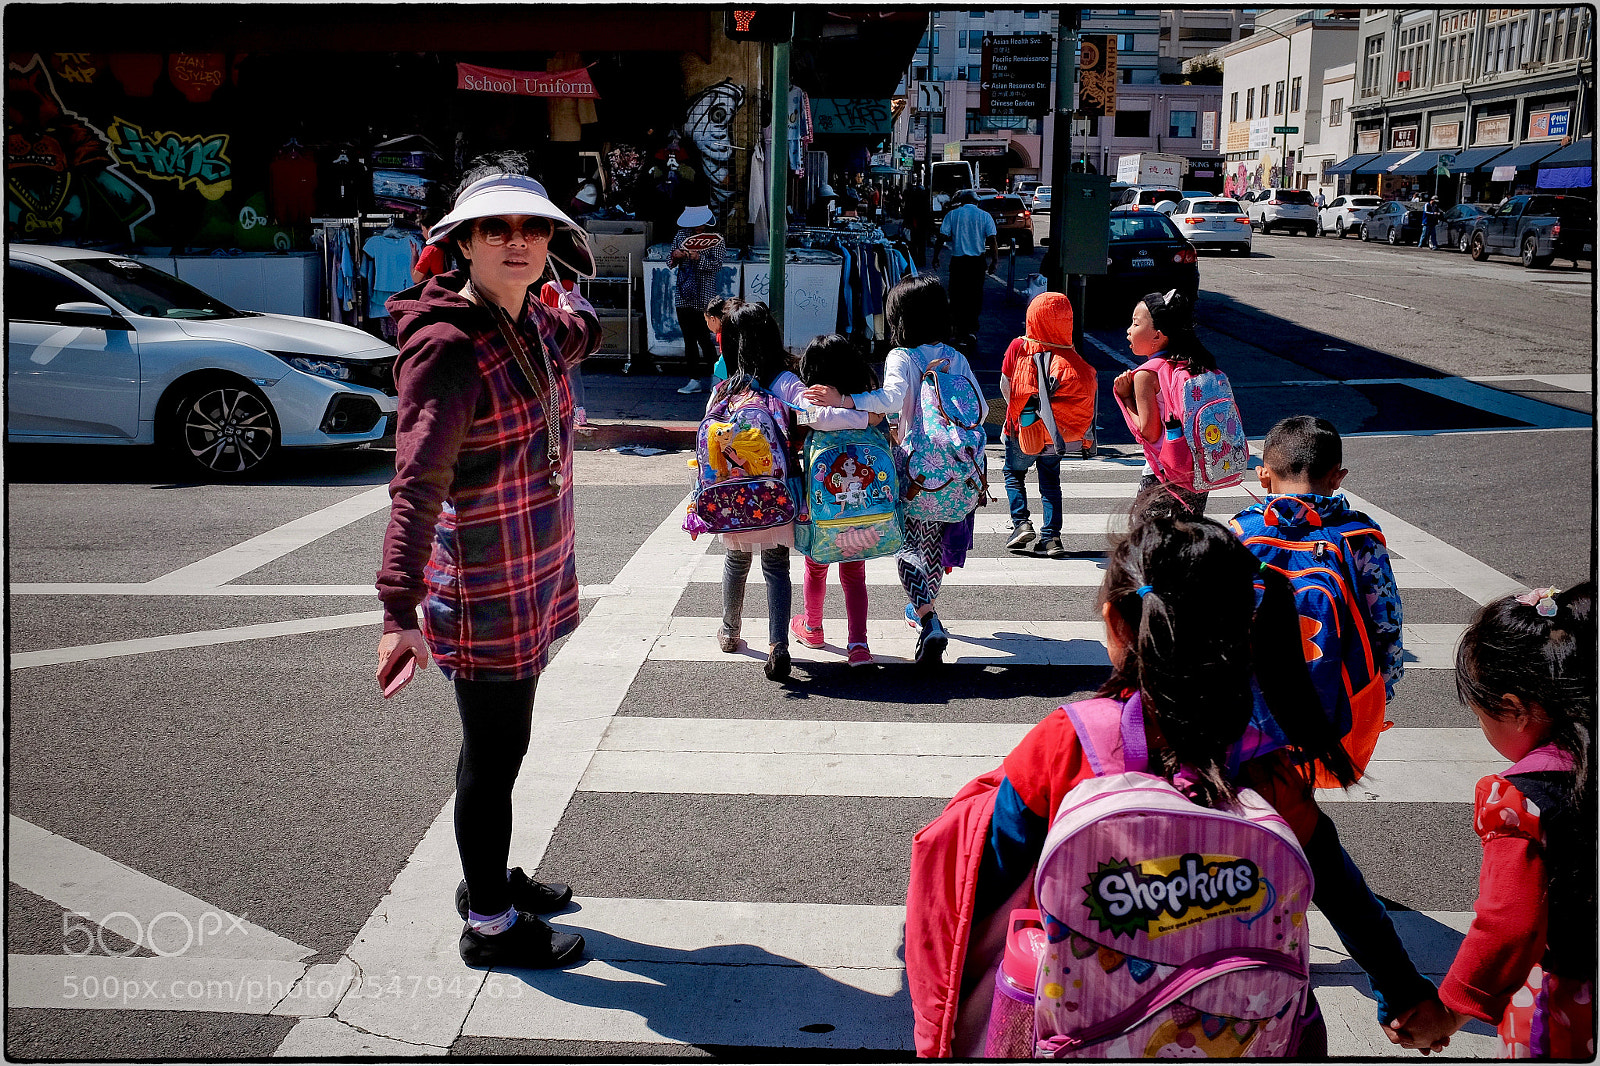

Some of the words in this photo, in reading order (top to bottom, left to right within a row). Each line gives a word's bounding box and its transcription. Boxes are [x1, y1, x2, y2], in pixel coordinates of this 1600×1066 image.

[992, 55, 1012, 63] Pacific
[991, 63, 1008, 71] Plaza
[1106, 38, 1116, 113] CHINATOWN
[464, 75, 517, 92] School
[523, 78, 594, 94] Uniform
[990, 99, 1014, 107] Chinese
[1014, 99, 1035, 107] Garden
[685, 237, 720, 247] STOP
[1098, 858, 1253, 917] Shopkins
[1158, 925, 1174, 933] Once
[1175, 921, 1187, 929] you
